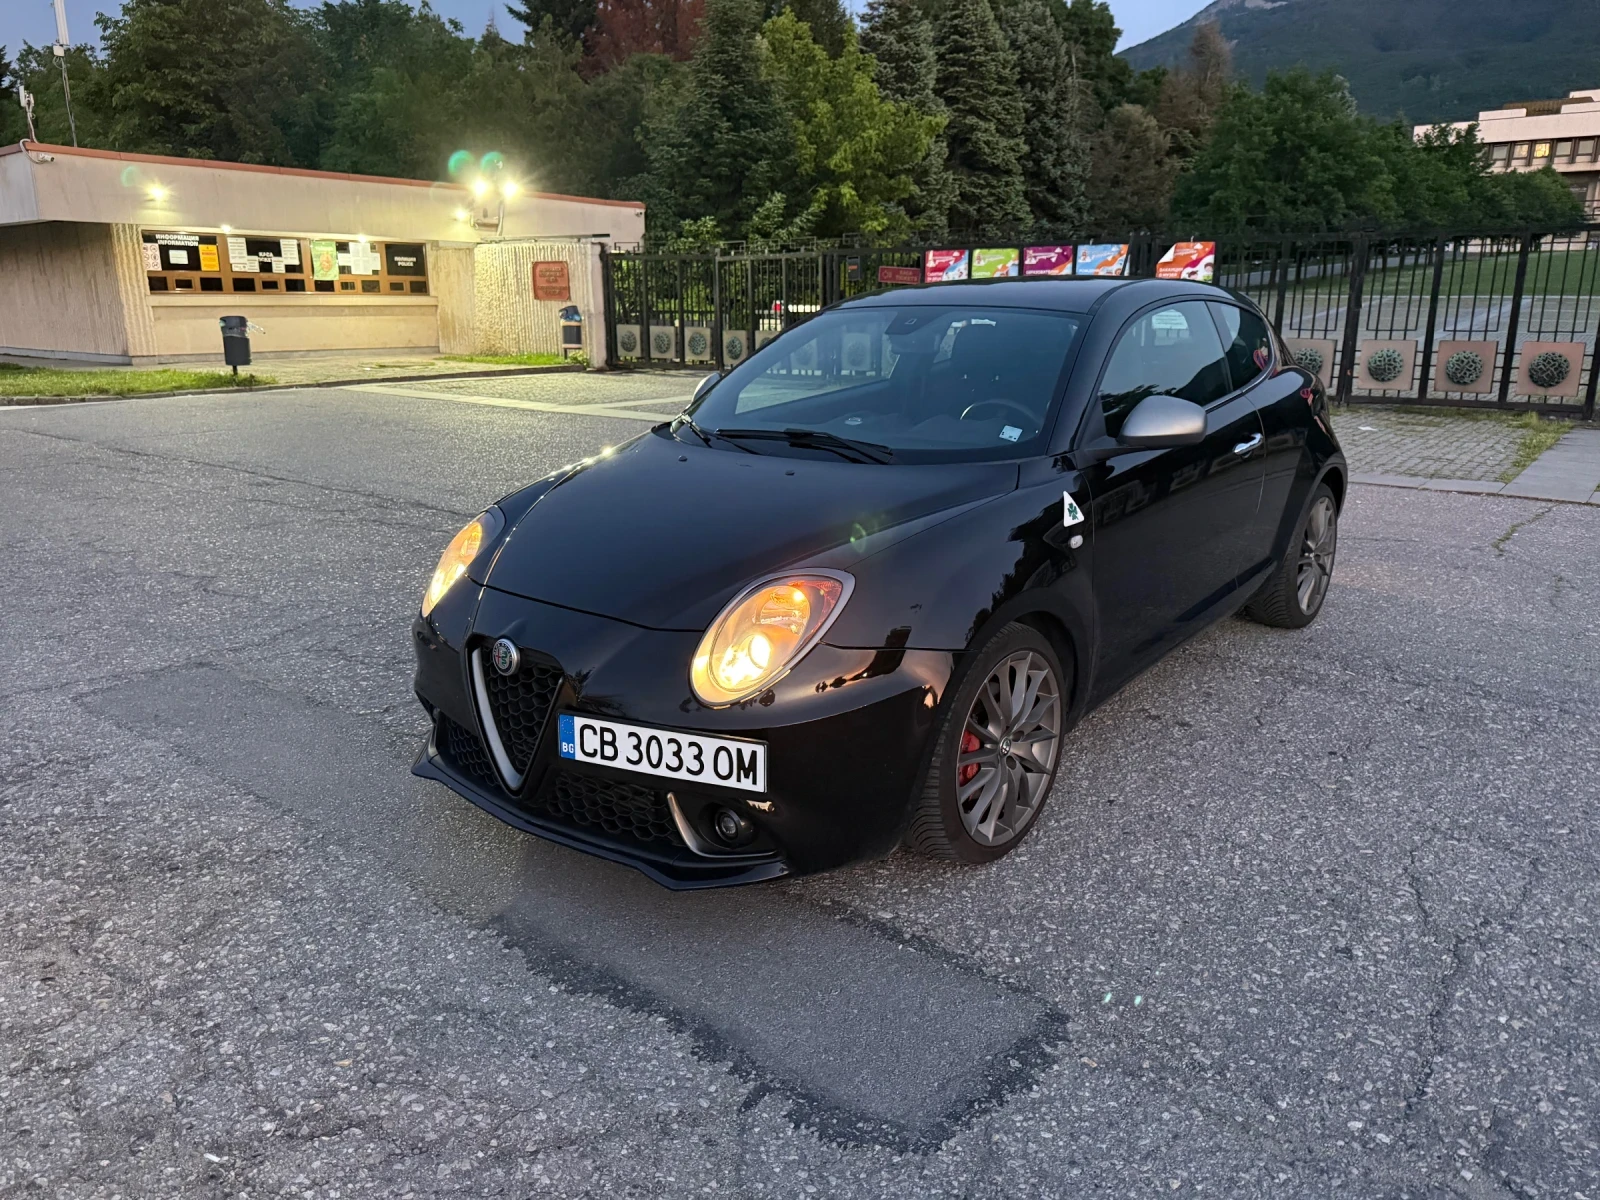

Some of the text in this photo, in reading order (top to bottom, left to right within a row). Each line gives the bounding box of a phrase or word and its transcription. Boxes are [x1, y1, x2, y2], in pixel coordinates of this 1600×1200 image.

[562, 742, 574, 754] BG
[580, 724, 758, 785] CB 3033 OM
